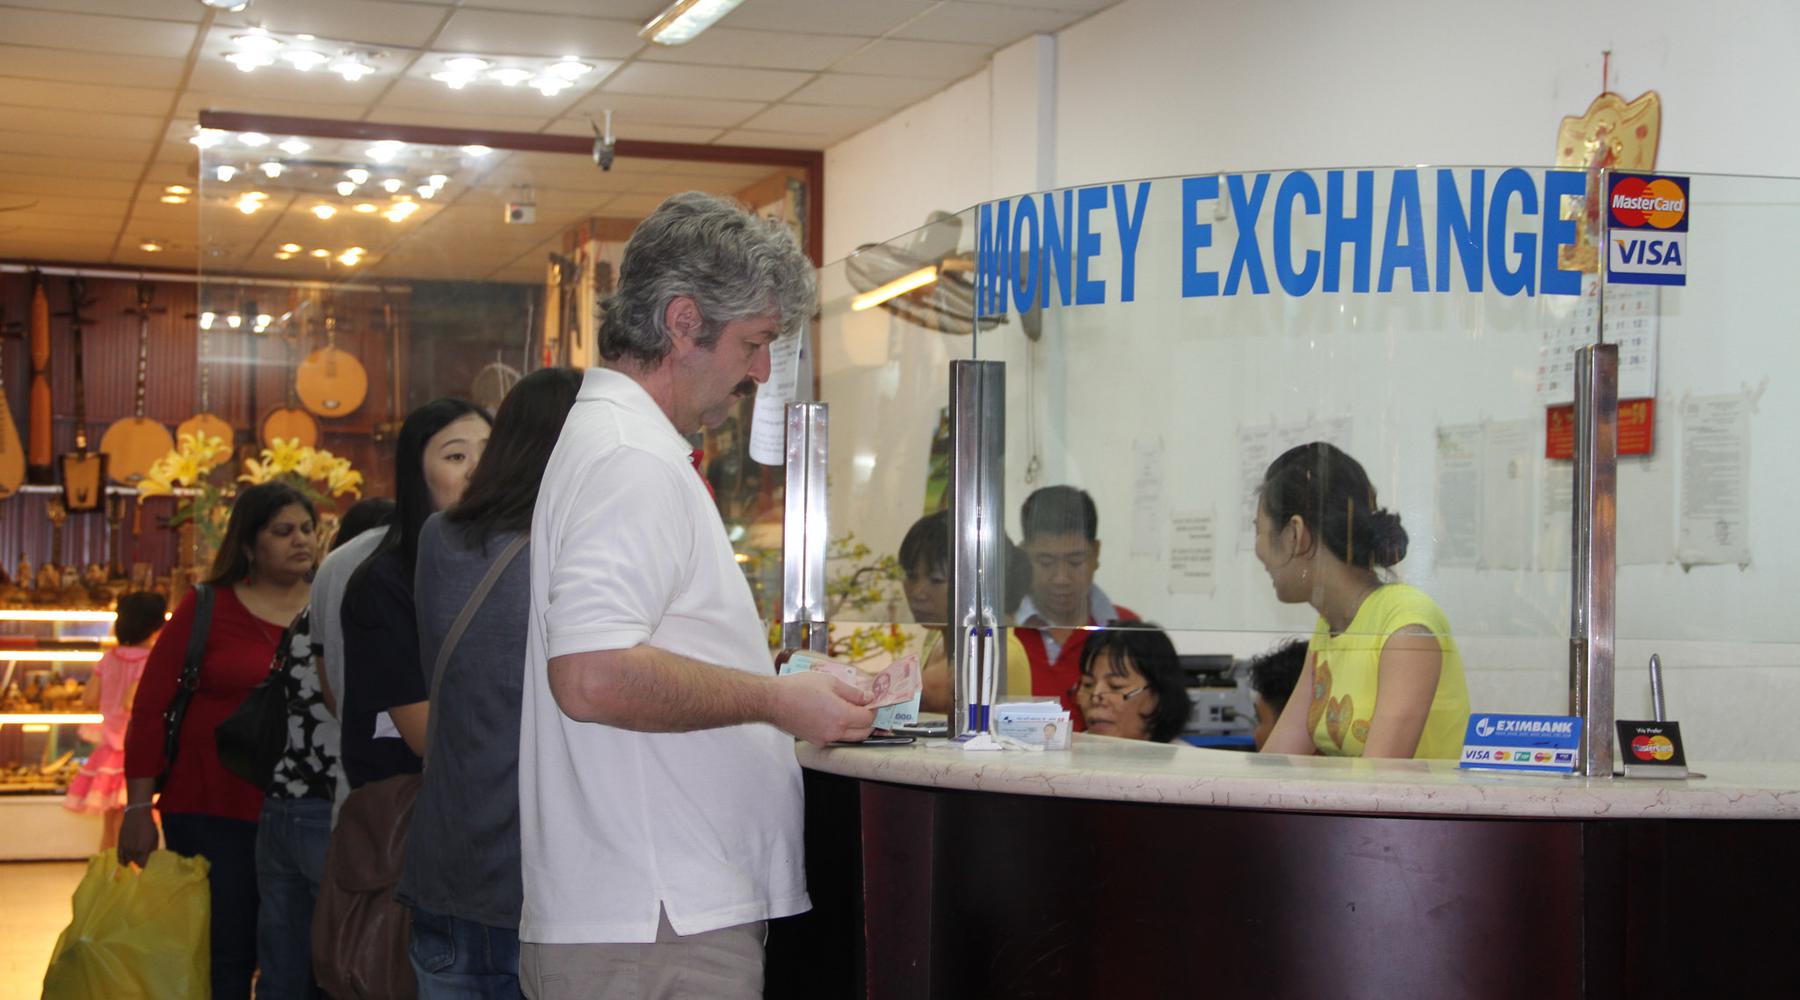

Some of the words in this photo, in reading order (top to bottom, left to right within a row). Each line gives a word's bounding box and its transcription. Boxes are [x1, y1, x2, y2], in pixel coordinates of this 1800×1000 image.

[1612, 194, 1684, 212] MasterCard
[977, 181, 1152, 318] MONEY
[1182, 168, 1587, 298] EXCHANGE
[1613, 239, 1682, 267] VISA
[1496, 720, 1573, 733] EXIMBANK
[1466, 750, 1490, 760] VISA
